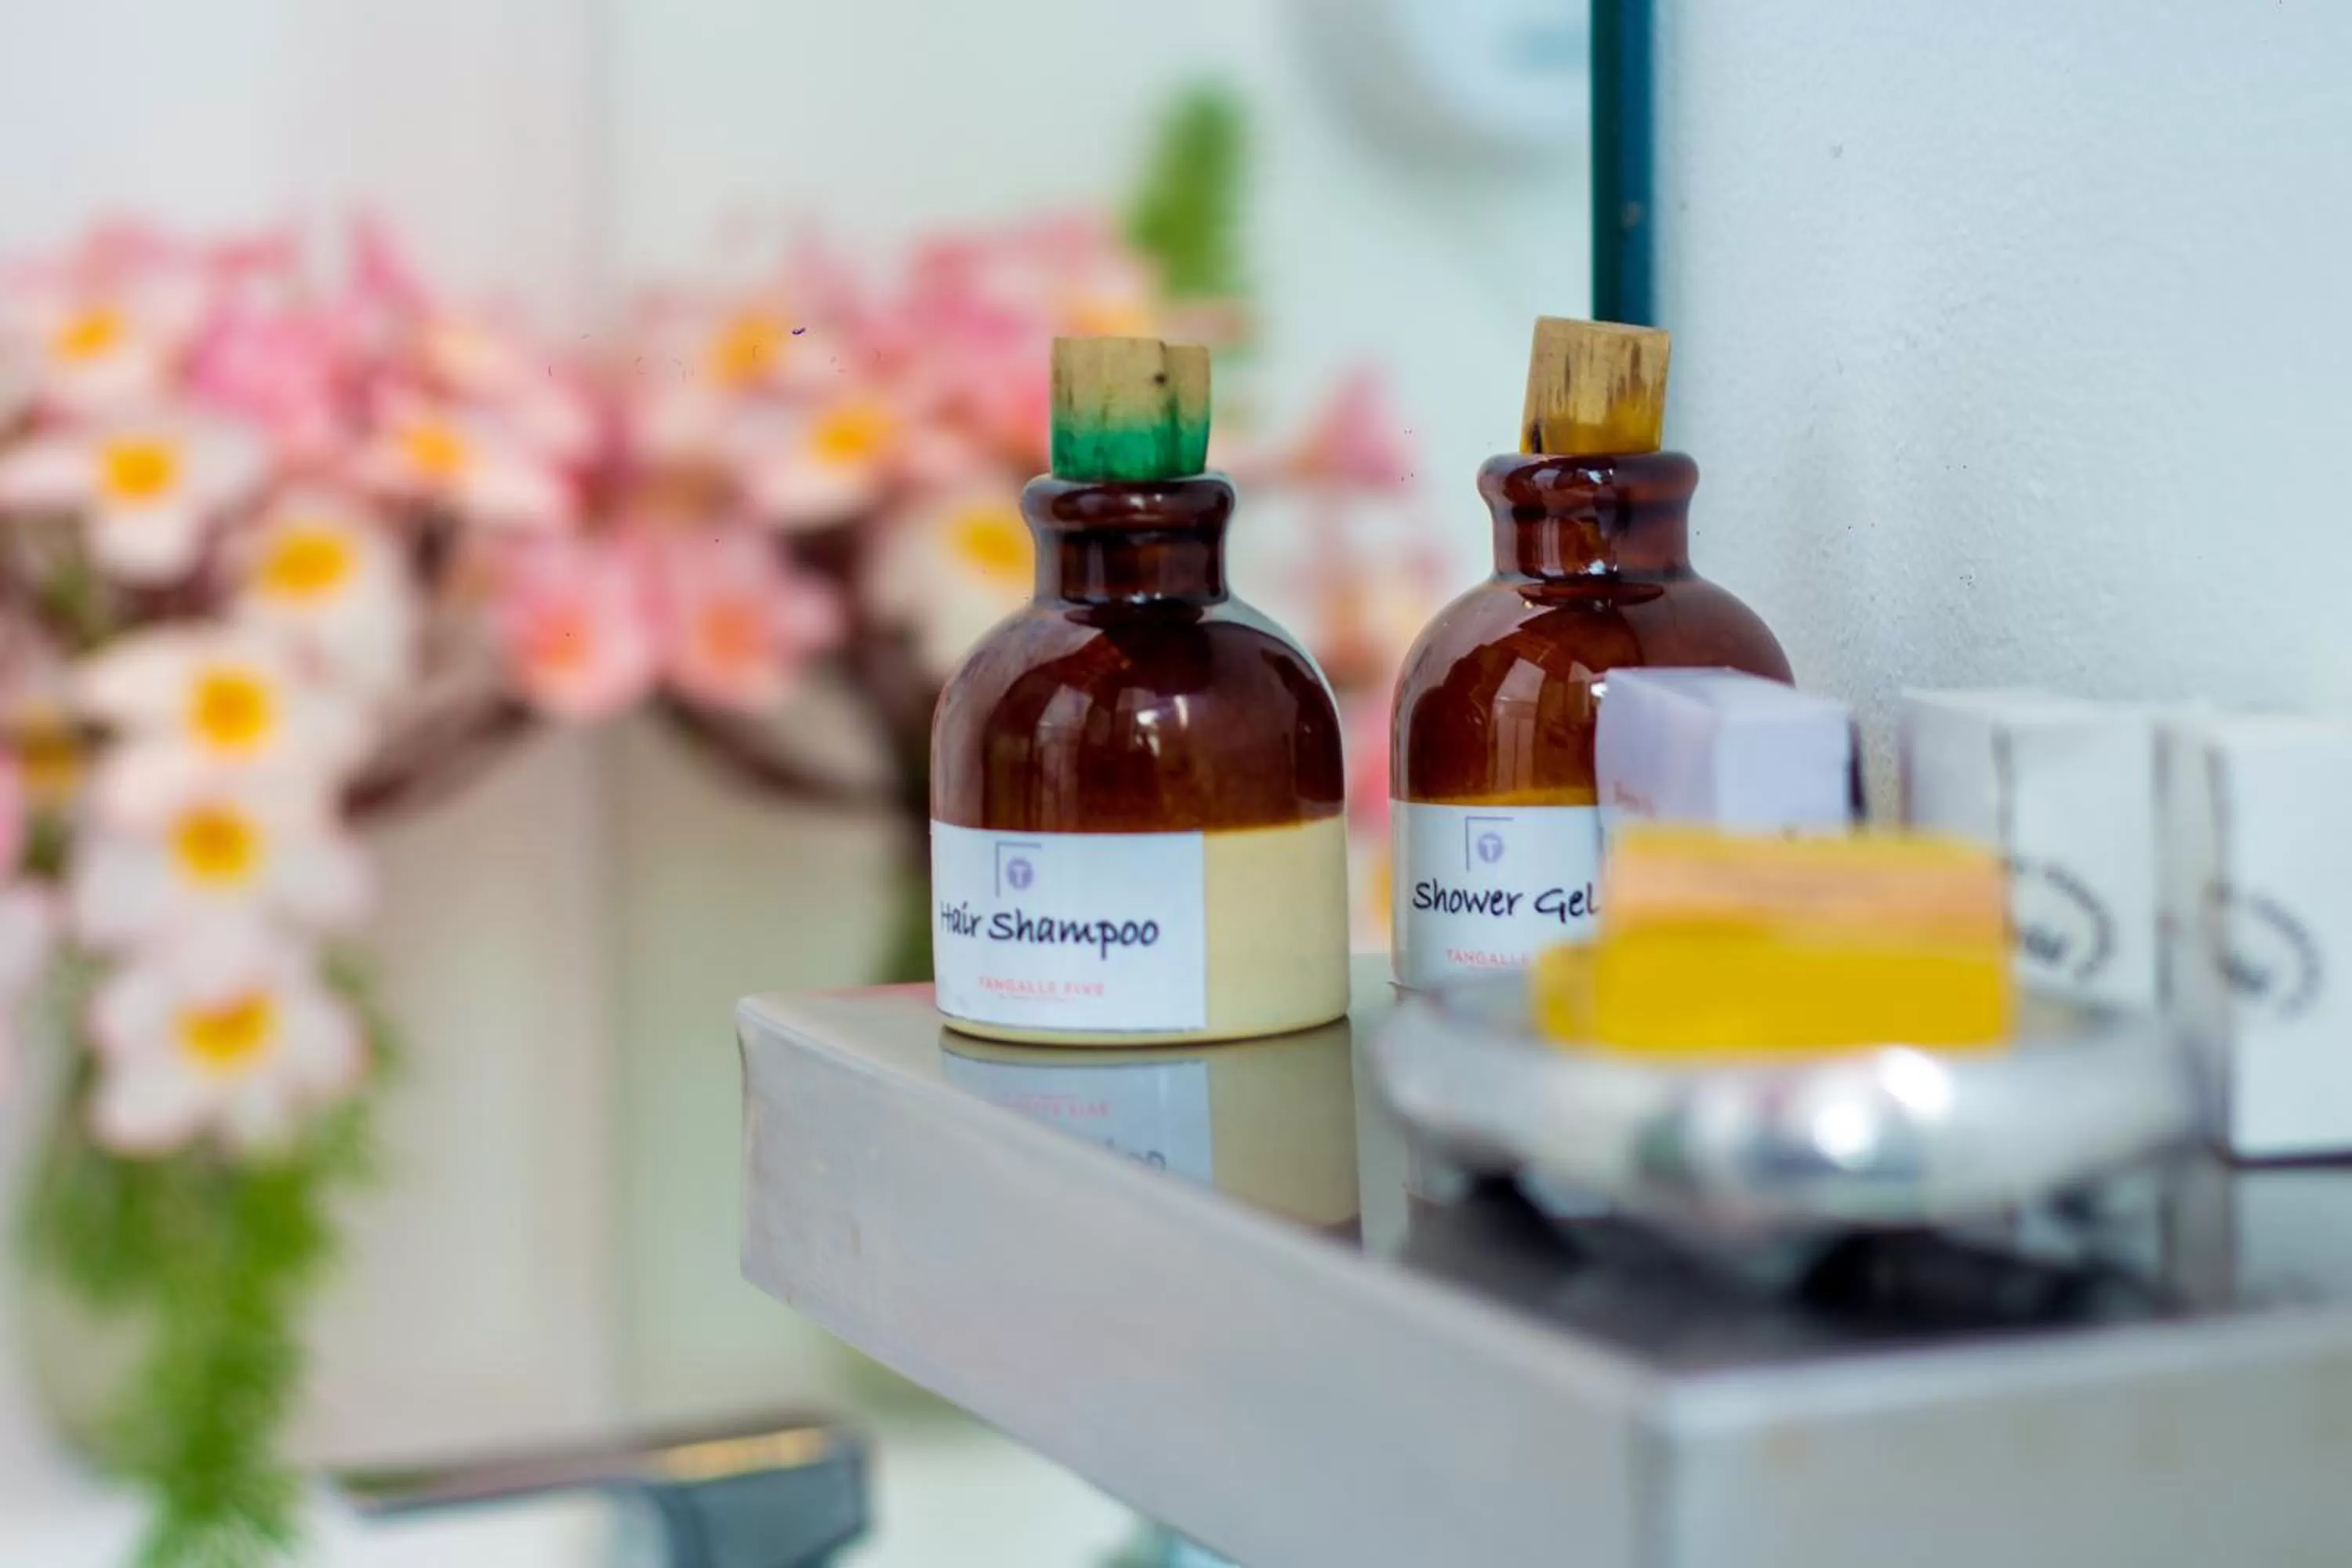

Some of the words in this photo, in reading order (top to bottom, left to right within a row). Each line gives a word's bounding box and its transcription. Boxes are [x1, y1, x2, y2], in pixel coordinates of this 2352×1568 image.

[1412, 877, 1524, 916] Shower
[1534, 880, 1600, 924] Gel
[940, 900, 983, 938] Hair
[987, 907, 1160, 961] Shampoo
